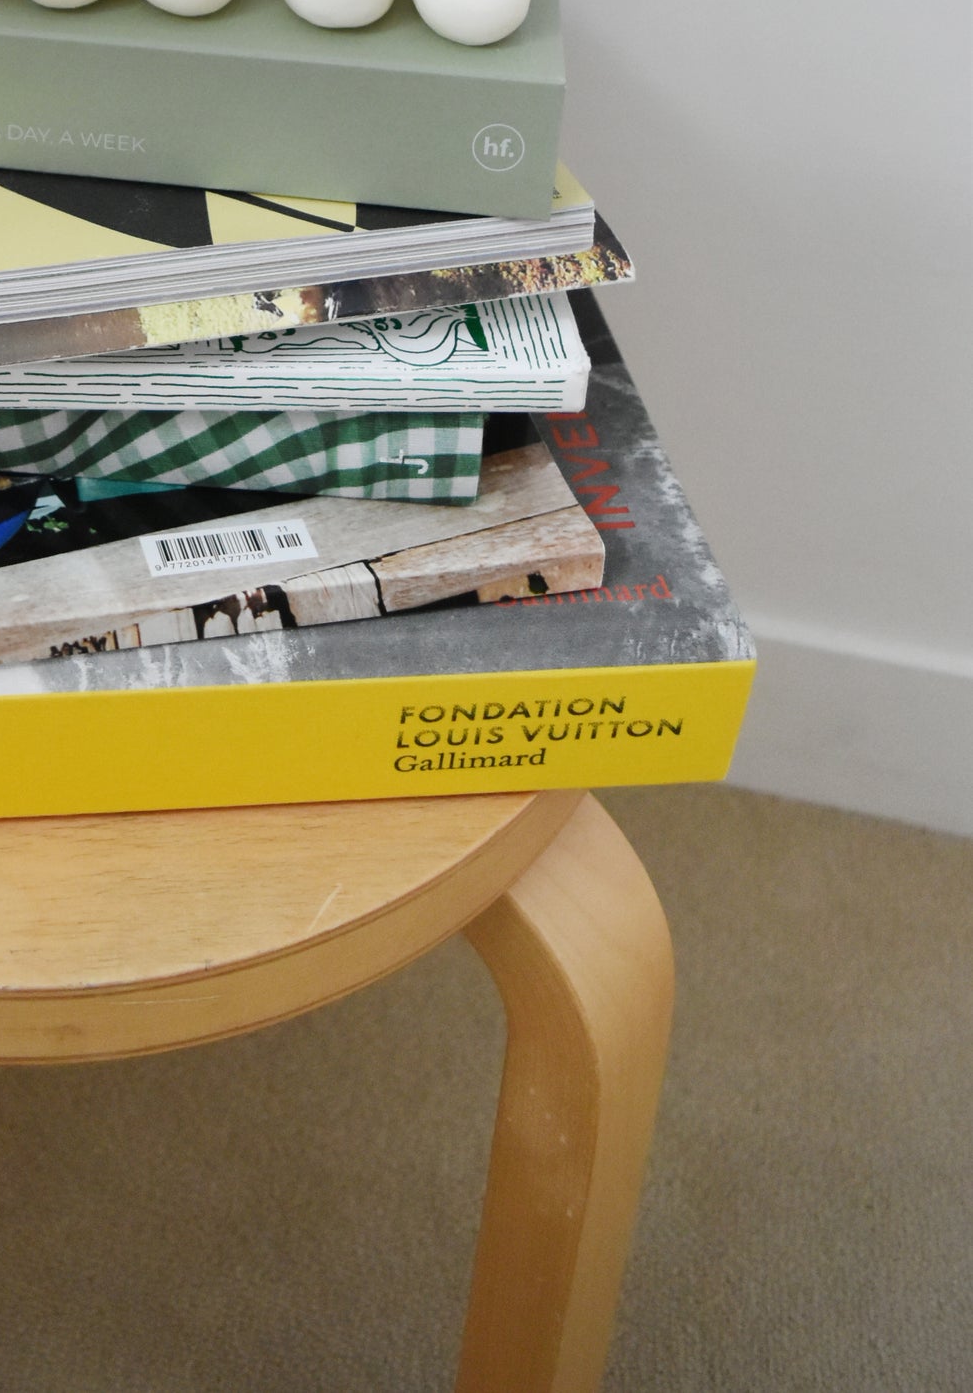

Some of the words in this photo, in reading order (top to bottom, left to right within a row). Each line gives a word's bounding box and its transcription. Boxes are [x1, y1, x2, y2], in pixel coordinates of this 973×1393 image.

[59, 130, 75, 146] A
[80, 132, 147, 153] WEEK
[544, 412, 636, 530] INVE
[400, 696, 627, 725] FONDATION
[396, 725, 504, 749] LOUIS
[522, 718, 684, 742] VUITTON
[393, 748, 547, 773] Gallimard
